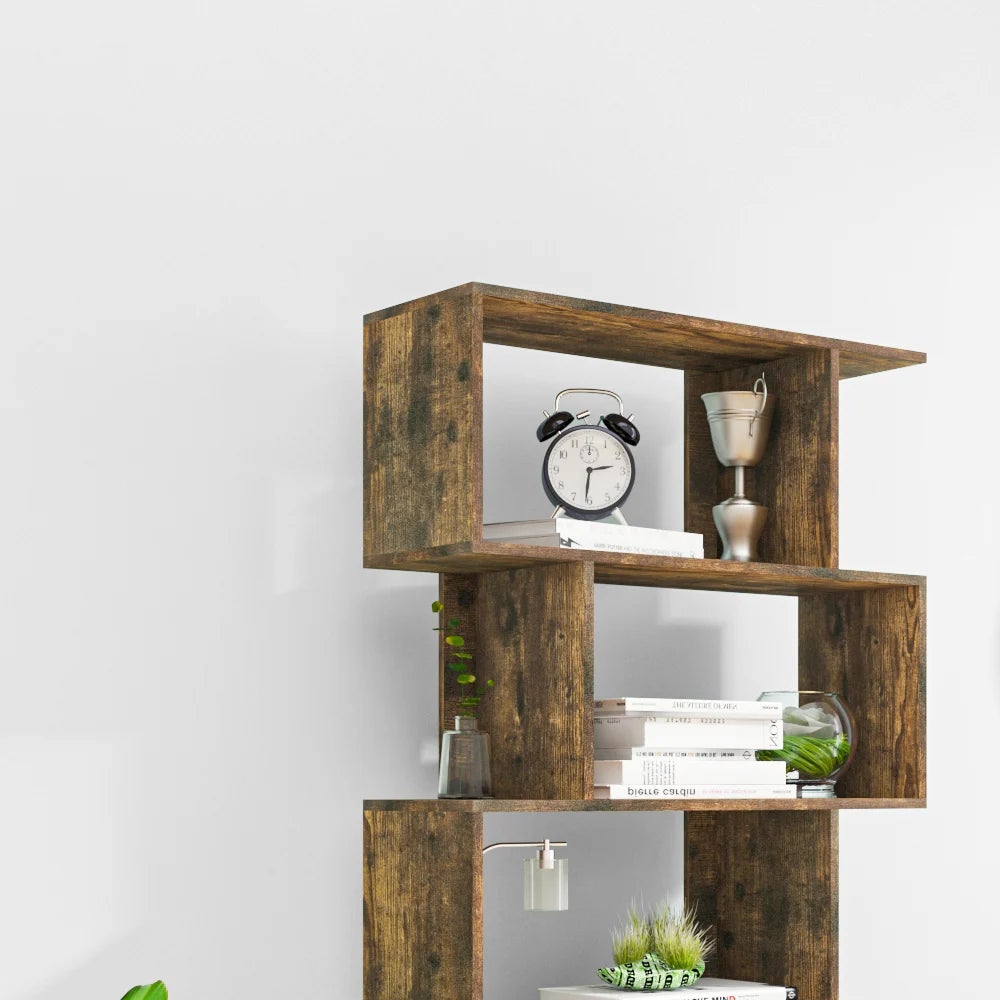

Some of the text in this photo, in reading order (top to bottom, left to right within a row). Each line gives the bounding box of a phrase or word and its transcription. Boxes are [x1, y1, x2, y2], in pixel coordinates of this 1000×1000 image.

[571, 439, 579, 448] 11
[559, 450, 567, 459] 10
[614, 450, 621, 460] 2
[553, 466, 559, 474] 9
[620, 467, 626, 475] 3
[570, 492, 577, 501] 7
[586, 496, 593, 505] 6
[605, 492, 611, 501] 5
